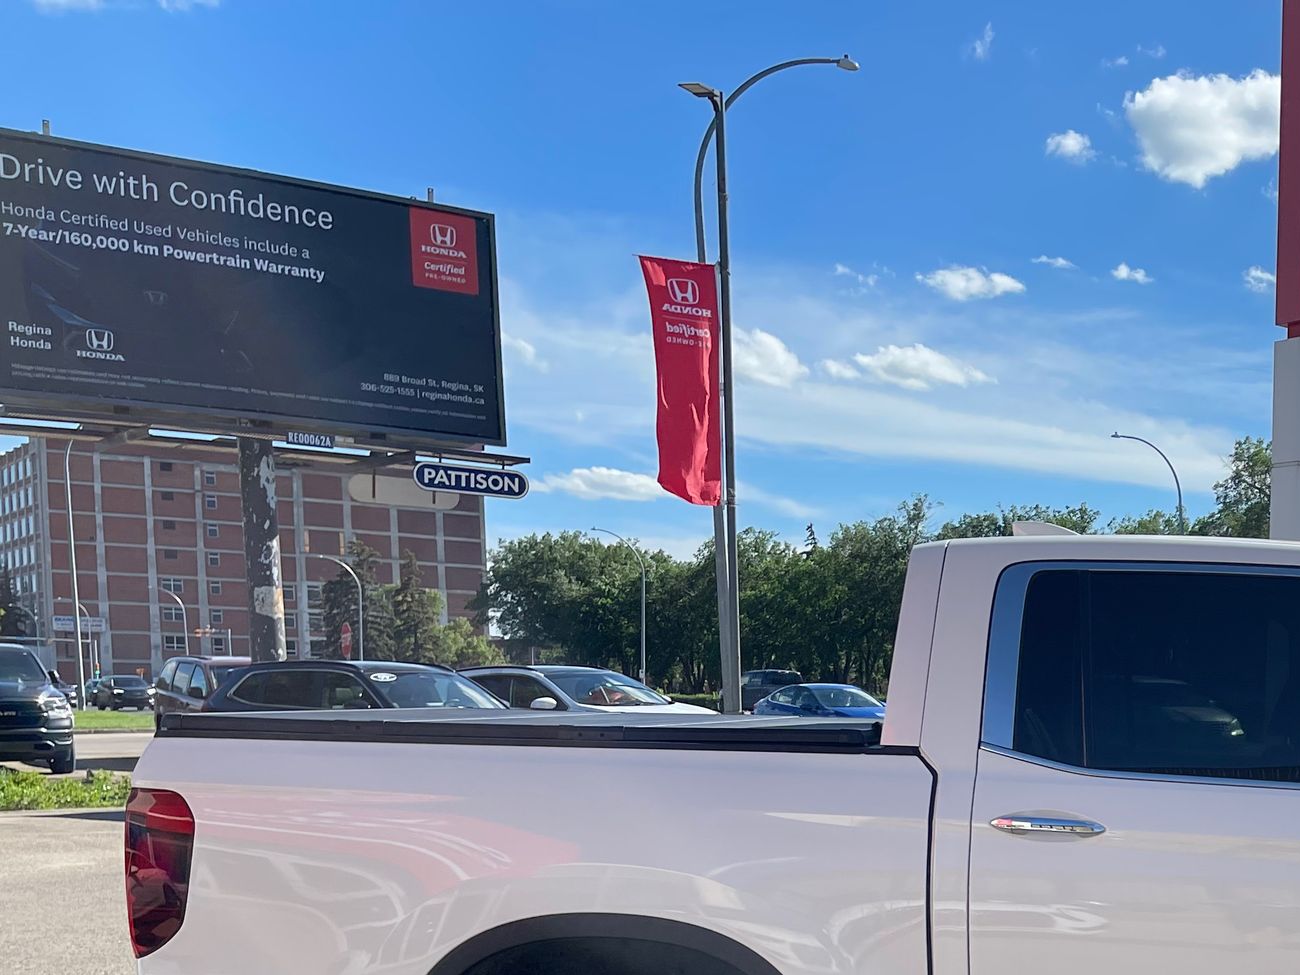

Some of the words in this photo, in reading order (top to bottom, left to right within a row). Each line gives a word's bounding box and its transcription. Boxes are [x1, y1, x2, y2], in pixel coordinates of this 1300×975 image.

[0, 153, 83, 190] Drive
[93, 171, 158, 202] with
[169, 181, 333, 230] Confidence
[1, 201, 55, 222] Honda
[60, 209, 128, 232] Certified
[133, 220, 172, 238] Used
[176, 226, 240, 249] Vehicles
[244, 236, 298, 257] include
[301, 248, 311, 260] a
[3, 222, 129, 251] 7-Year/160,000
[133, 239, 159, 257] km
[163, 245, 250, 270] Powertrain
[253, 257, 325, 283] Warranty
[421, 245, 467, 259] HONDA
[424, 261, 465, 275] Certified
[8, 321, 52, 336] Regina
[10, 336, 52, 350] Honda
[76, 350, 126, 362] HONDA
[401, 375, 426, 386] Broad
[473, 384, 485, 393] SK
[421, 391, 485, 405] reginahonda.ca
[423, 467, 520, 494] PATTISON
